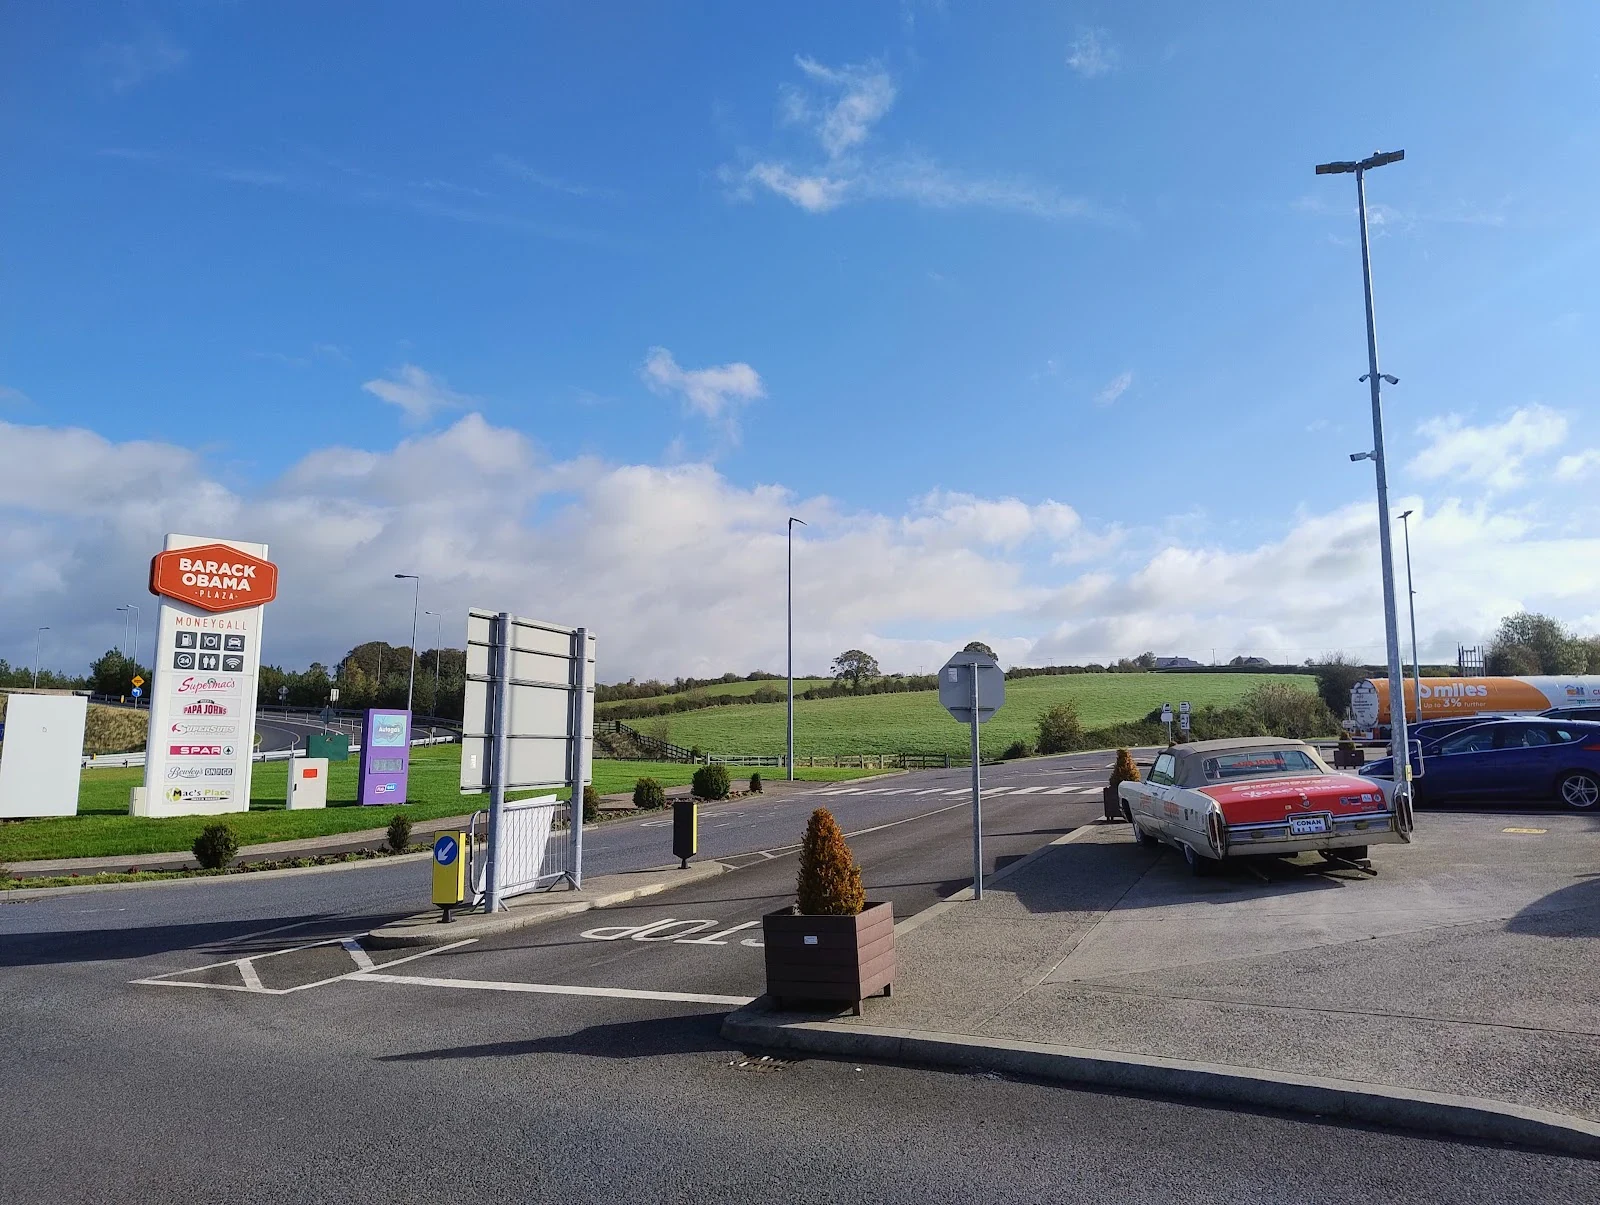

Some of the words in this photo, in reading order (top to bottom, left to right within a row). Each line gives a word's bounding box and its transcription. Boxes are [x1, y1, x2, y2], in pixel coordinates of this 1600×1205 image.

[179, 558, 256, 578] BARACK
[182, 573, 251, 591] OBAMA
[199, 589, 234, 600] PLAZA
[175, 616, 247, 631] MONEYGALL
[179, 656, 190, 664] 24
[177, 677, 235, 694] Supermac's
[1434, 683, 1488, 697] miles
[1443, 698, 1462, 708] 3%
[183, 704, 202, 714] PAPA
[378, 726, 401, 734] Autogas
[180, 746, 221, 755] SPAR
[173, 789, 201, 797] Mac's
